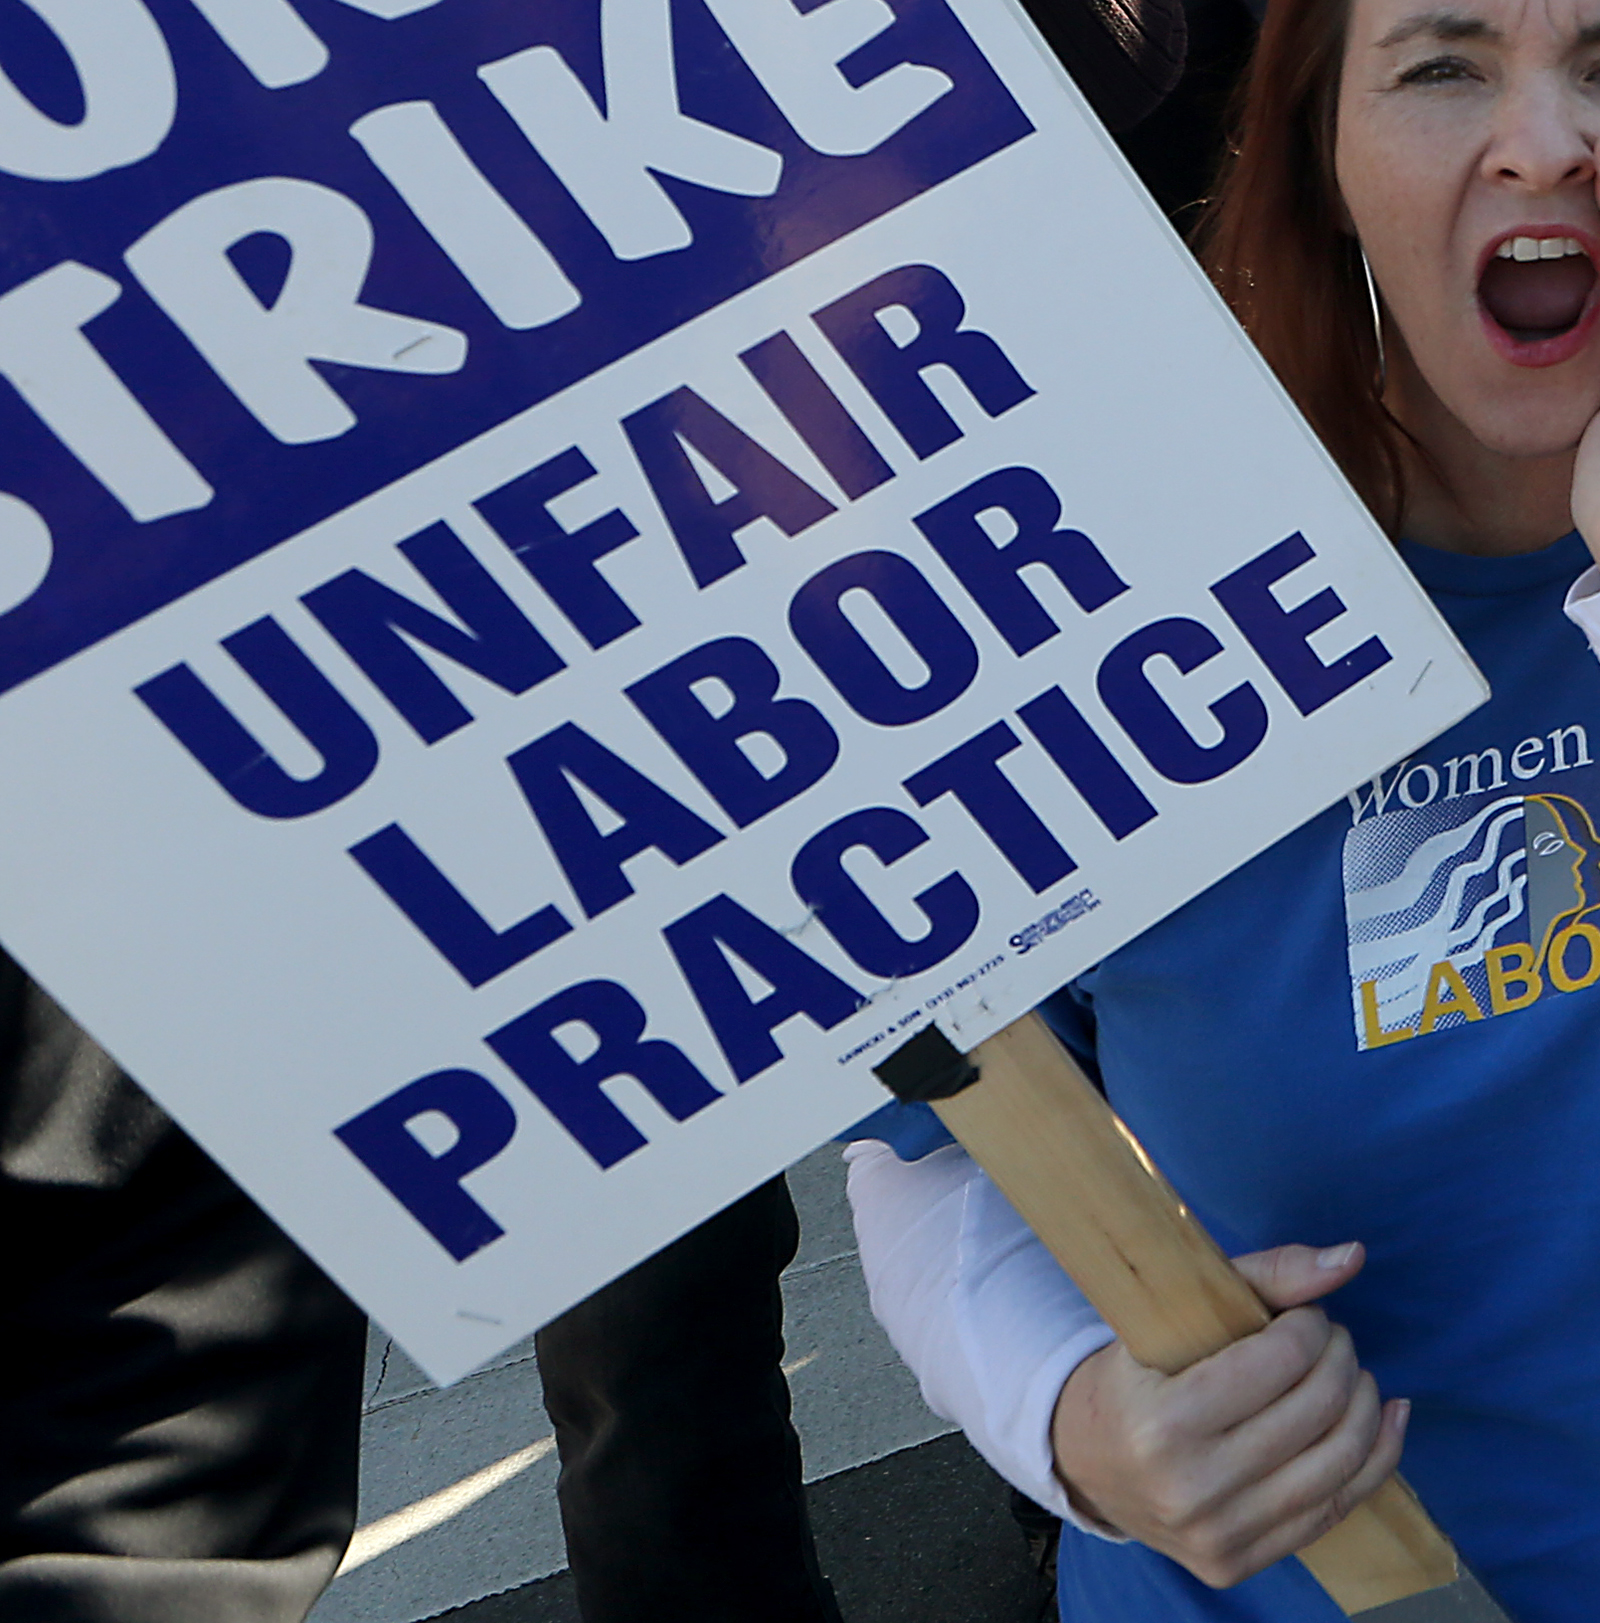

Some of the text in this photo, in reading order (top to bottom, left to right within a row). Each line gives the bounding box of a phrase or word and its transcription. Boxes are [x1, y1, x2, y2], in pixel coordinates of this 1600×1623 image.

[133, 259, 1041, 824] UNFAIR
[345, 459, 1133, 992] LABOR
[1347, 723, 1595, 827] Women
[330, 526, 1396, 1264] PRACTICE
